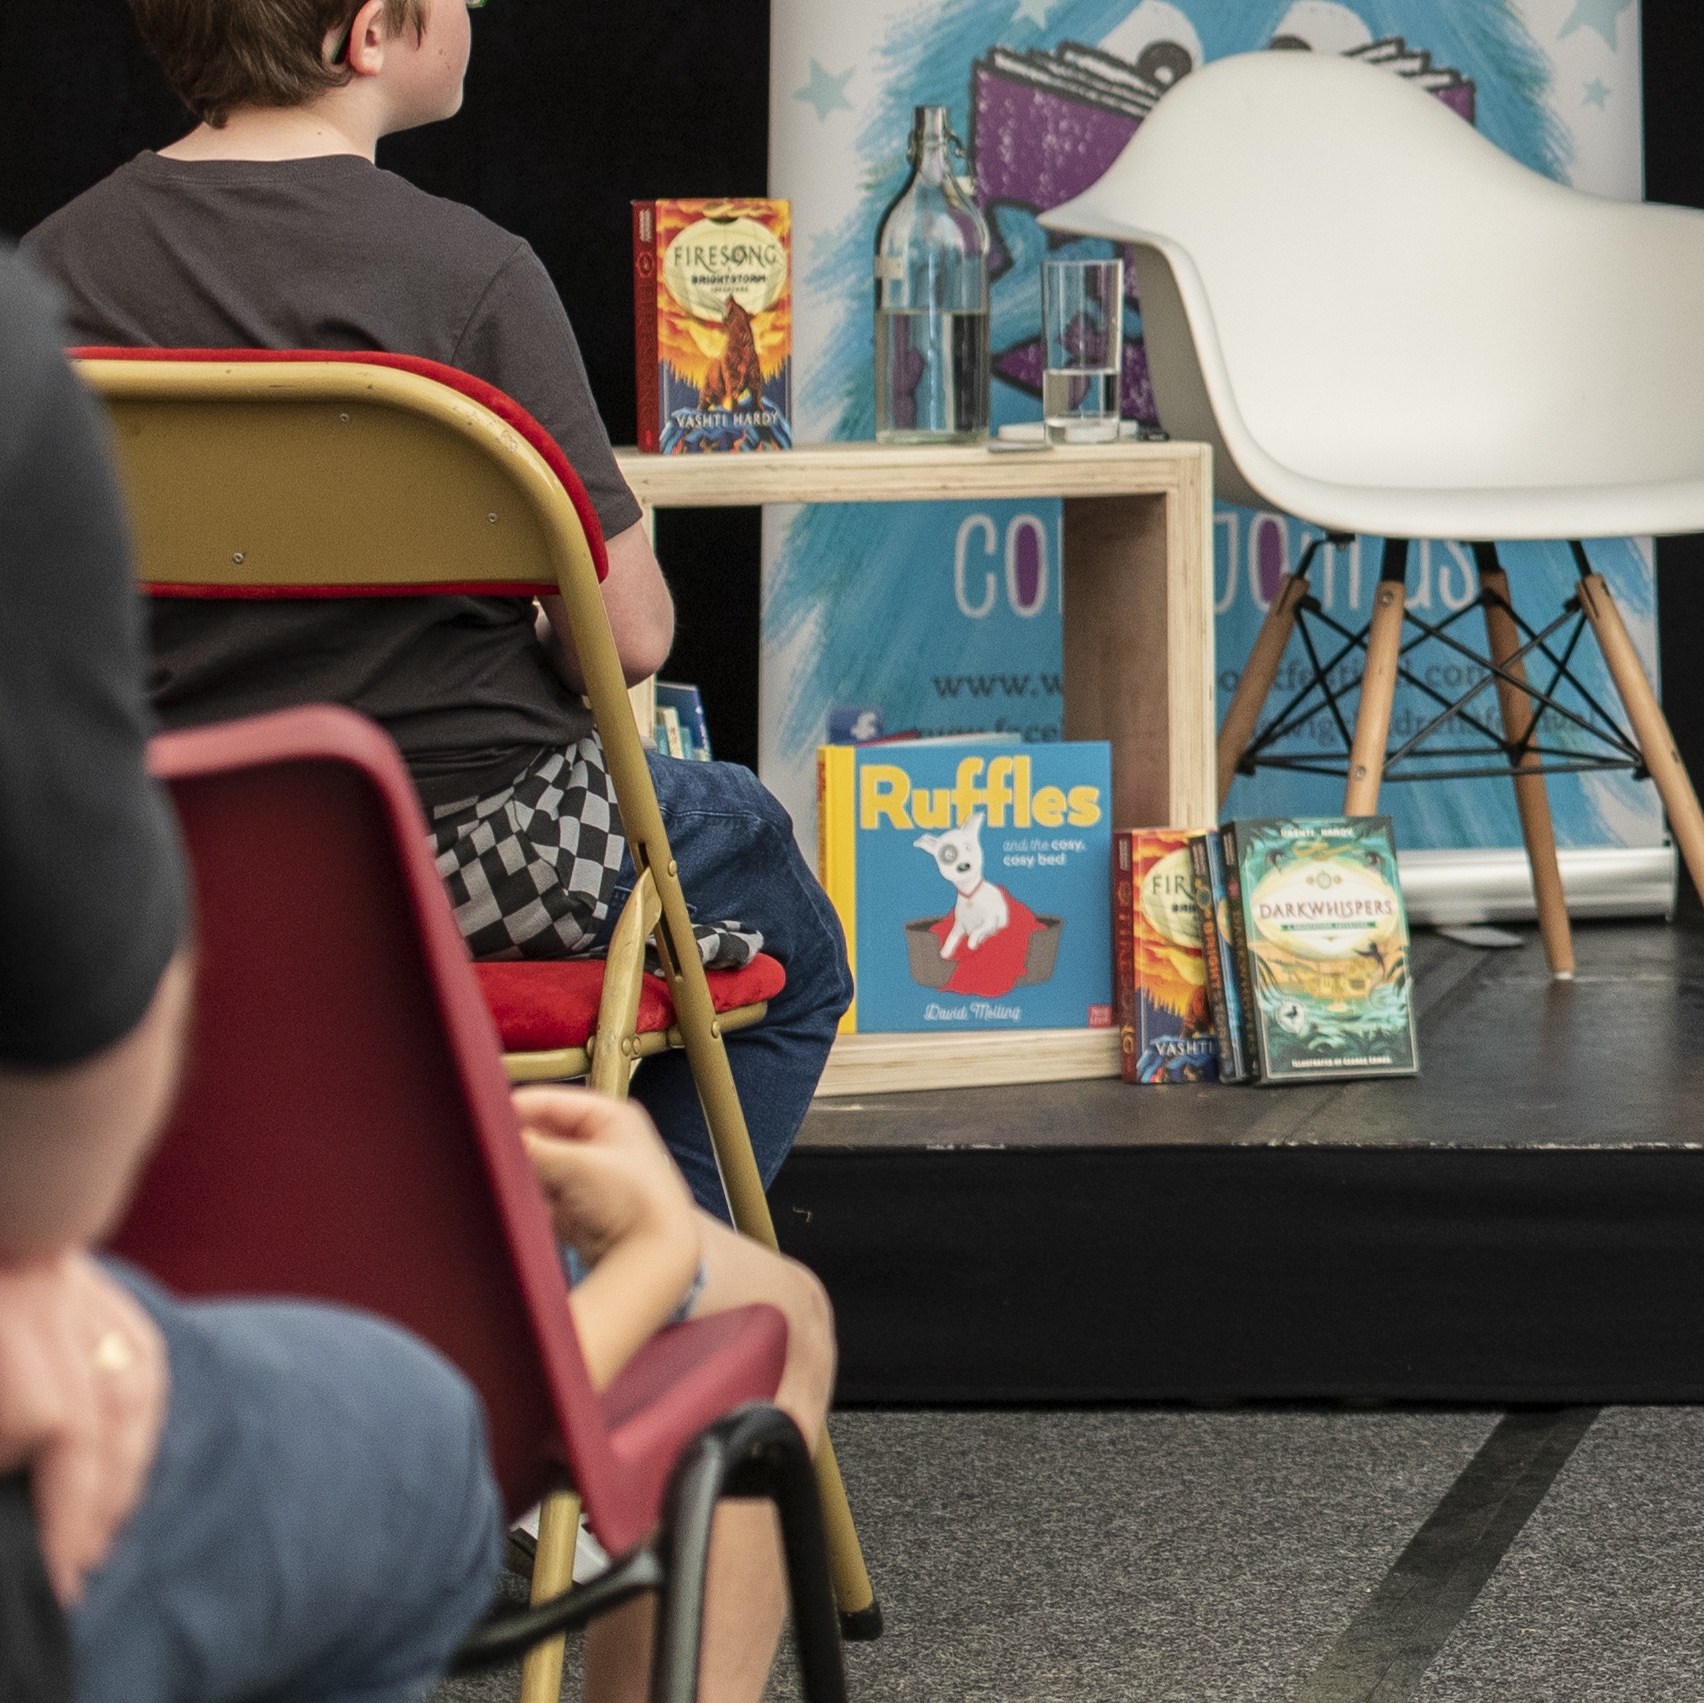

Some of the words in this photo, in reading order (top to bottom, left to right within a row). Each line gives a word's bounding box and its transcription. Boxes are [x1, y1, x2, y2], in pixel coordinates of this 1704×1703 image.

[674, 246, 777, 273] FIRESONG
[676, 413, 728, 429] VASHTI
[733, 411, 778, 428] HARDY
[954, 513, 1062, 618] CO
[860, 755, 1101, 829] Ruffles
[1003, 839, 1028, 852] and
[1030, 838, 1049, 851] the
[1003, 854, 1034, 868] cosy
[1038, 852, 1066, 866] bed
[1259, 899, 1393, 920] DARKWHISPERS
[1155, 1042, 1212, 1057] VASHTI
